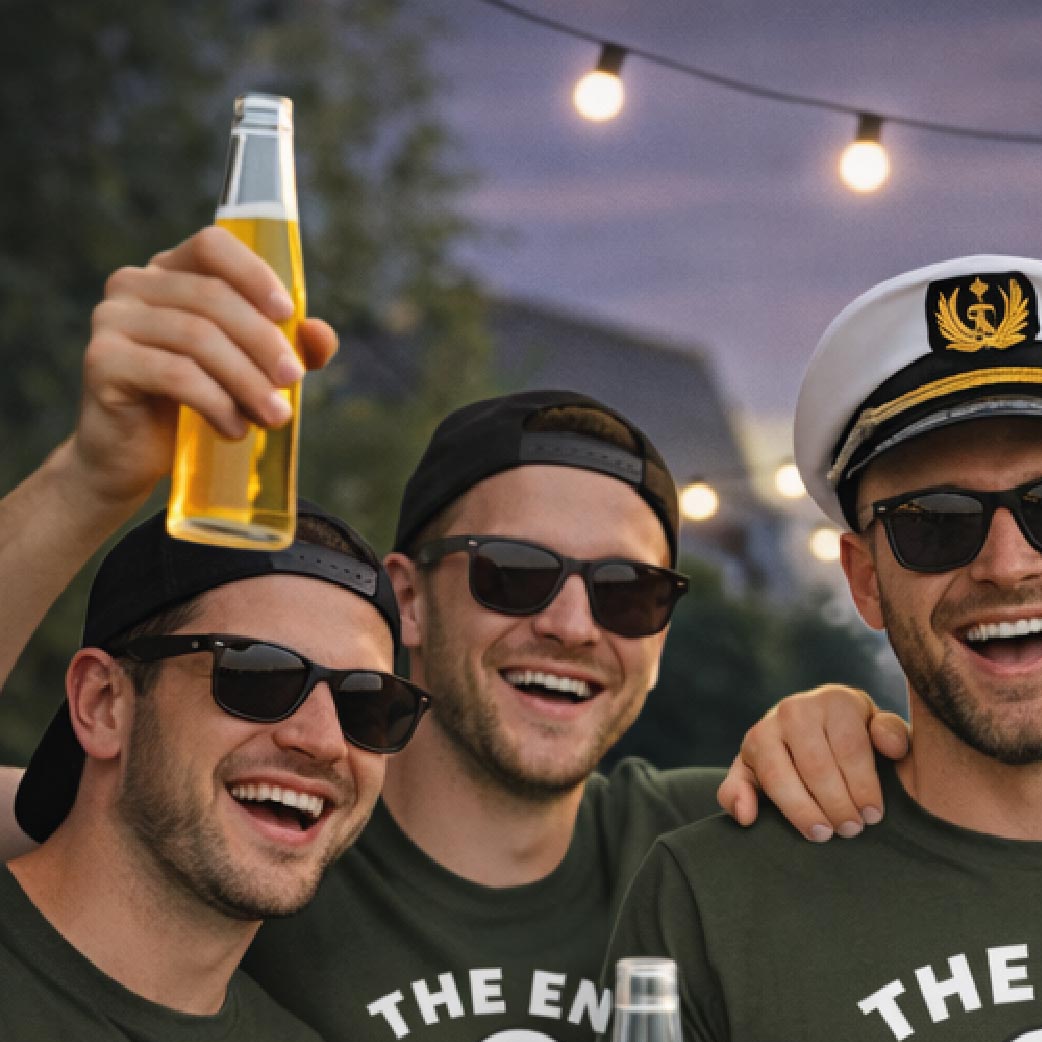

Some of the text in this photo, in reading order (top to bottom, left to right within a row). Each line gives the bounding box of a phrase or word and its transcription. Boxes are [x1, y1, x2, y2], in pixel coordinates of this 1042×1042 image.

[366, 967, 613, 1041] THE EN
[857, 943, 1036, 1042] THE
